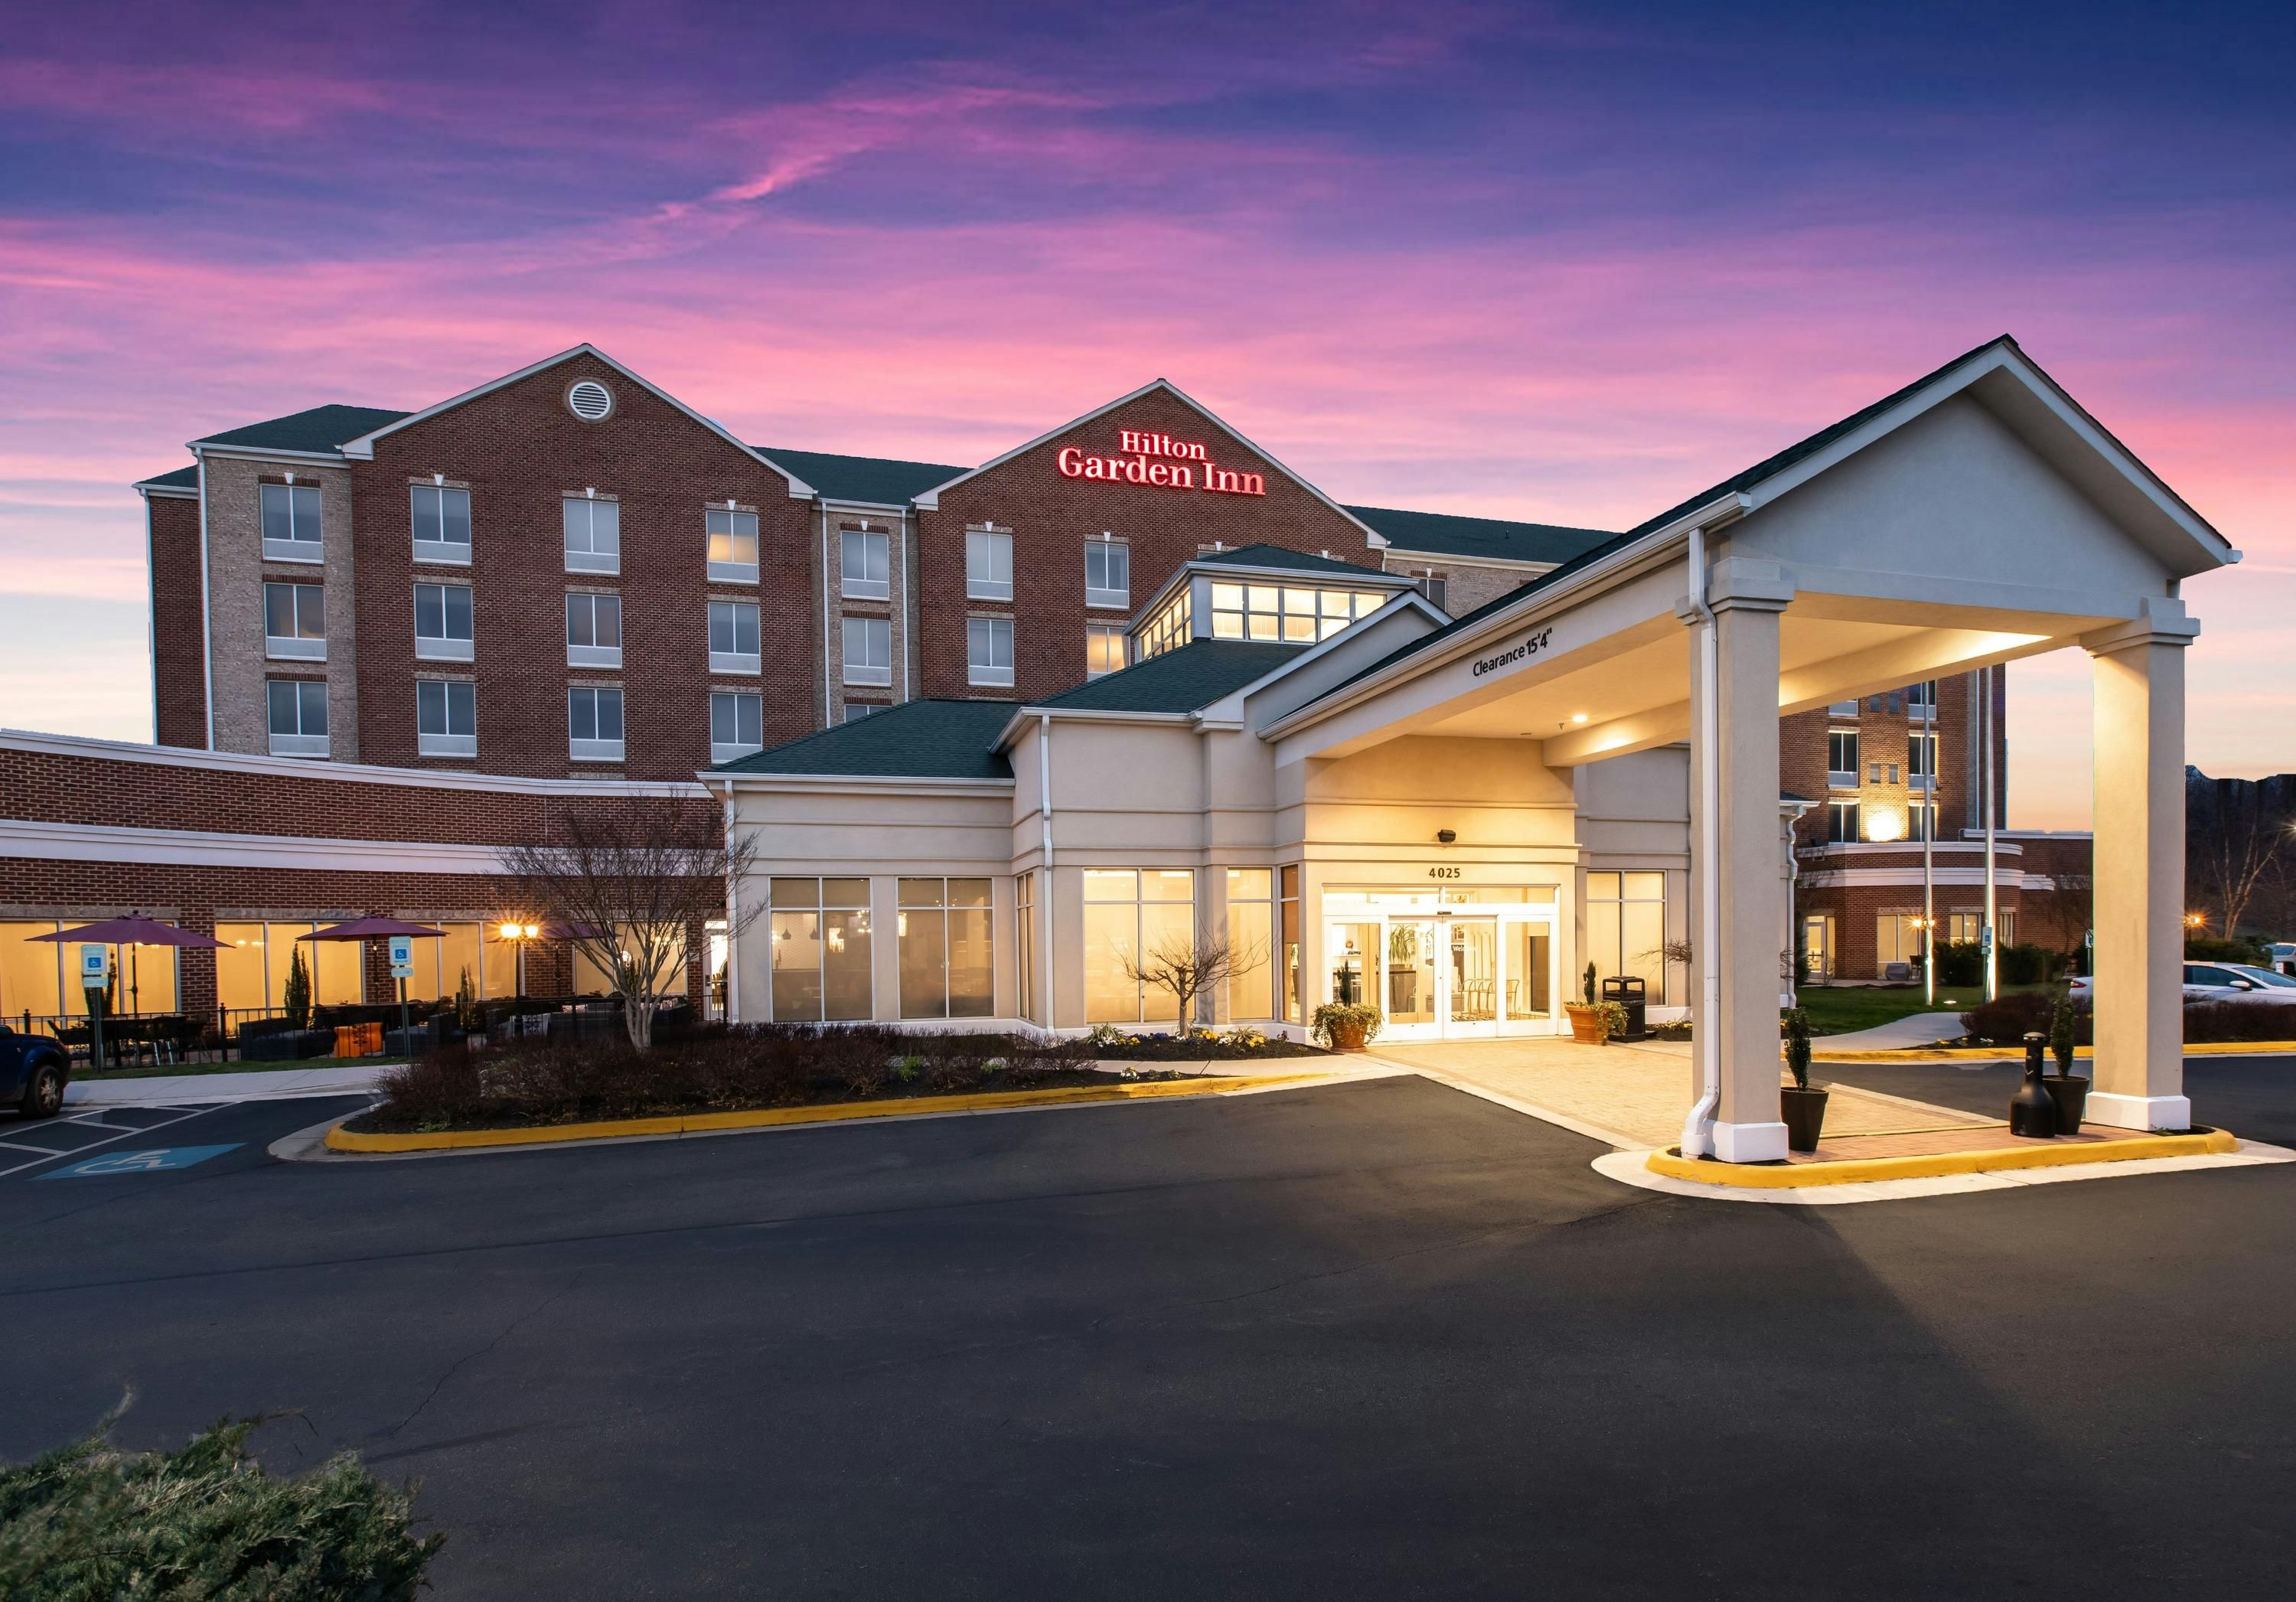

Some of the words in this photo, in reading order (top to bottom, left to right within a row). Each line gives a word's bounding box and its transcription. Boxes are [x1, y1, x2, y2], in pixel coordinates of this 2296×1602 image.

[1120, 429, 1207, 461] Hilton
[1058, 447, 1194, 489] Garden
[1202, 462, 1266, 496] Inn
[1473, 646, 1525, 677] Clearance
[1526, 628, 1552, 655] 15'4"
[1429, 868, 1460, 878] 4025
